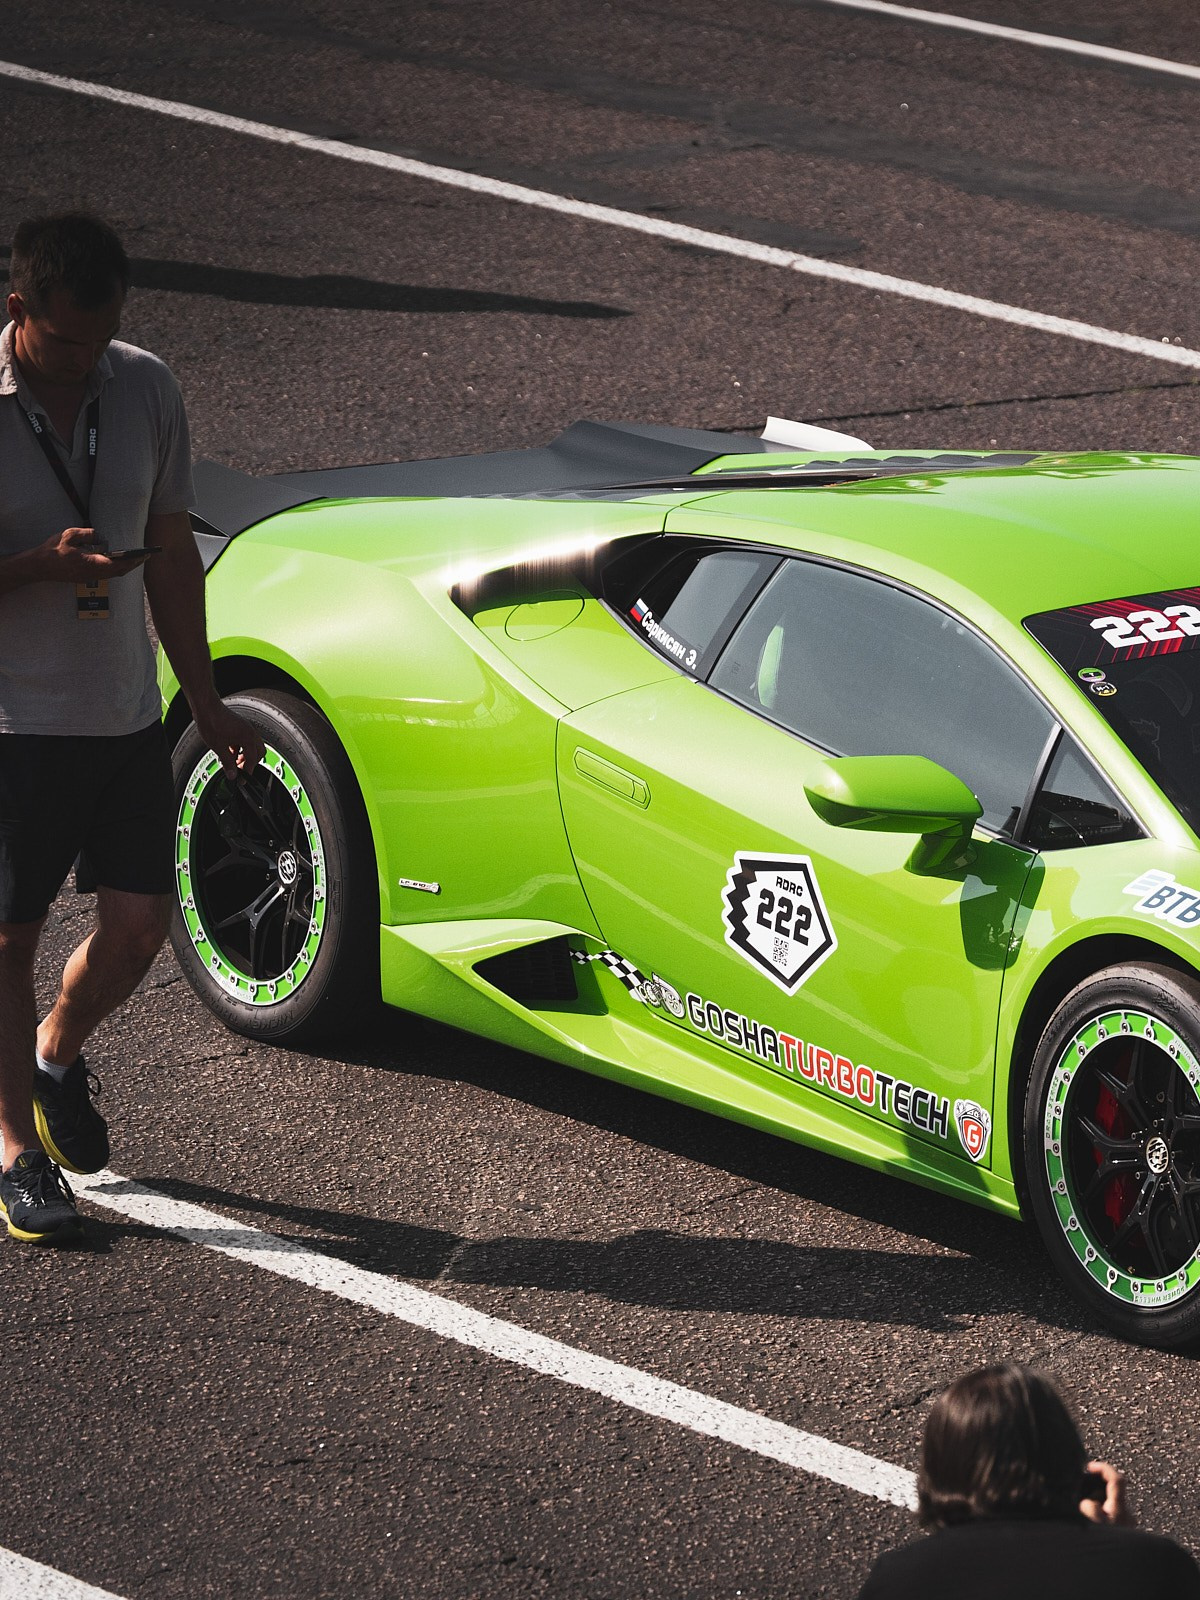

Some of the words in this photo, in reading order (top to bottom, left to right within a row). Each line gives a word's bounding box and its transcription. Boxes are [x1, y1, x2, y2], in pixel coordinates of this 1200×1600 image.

[89, 428, 97, 456] RDRC
[641, 611, 687, 660] Саркисян
[775, 876, 804, 897] RDRC
[756, 888, 812, 947] 222
[687, 994, 950, 1138] GOSHATURBOTECH
